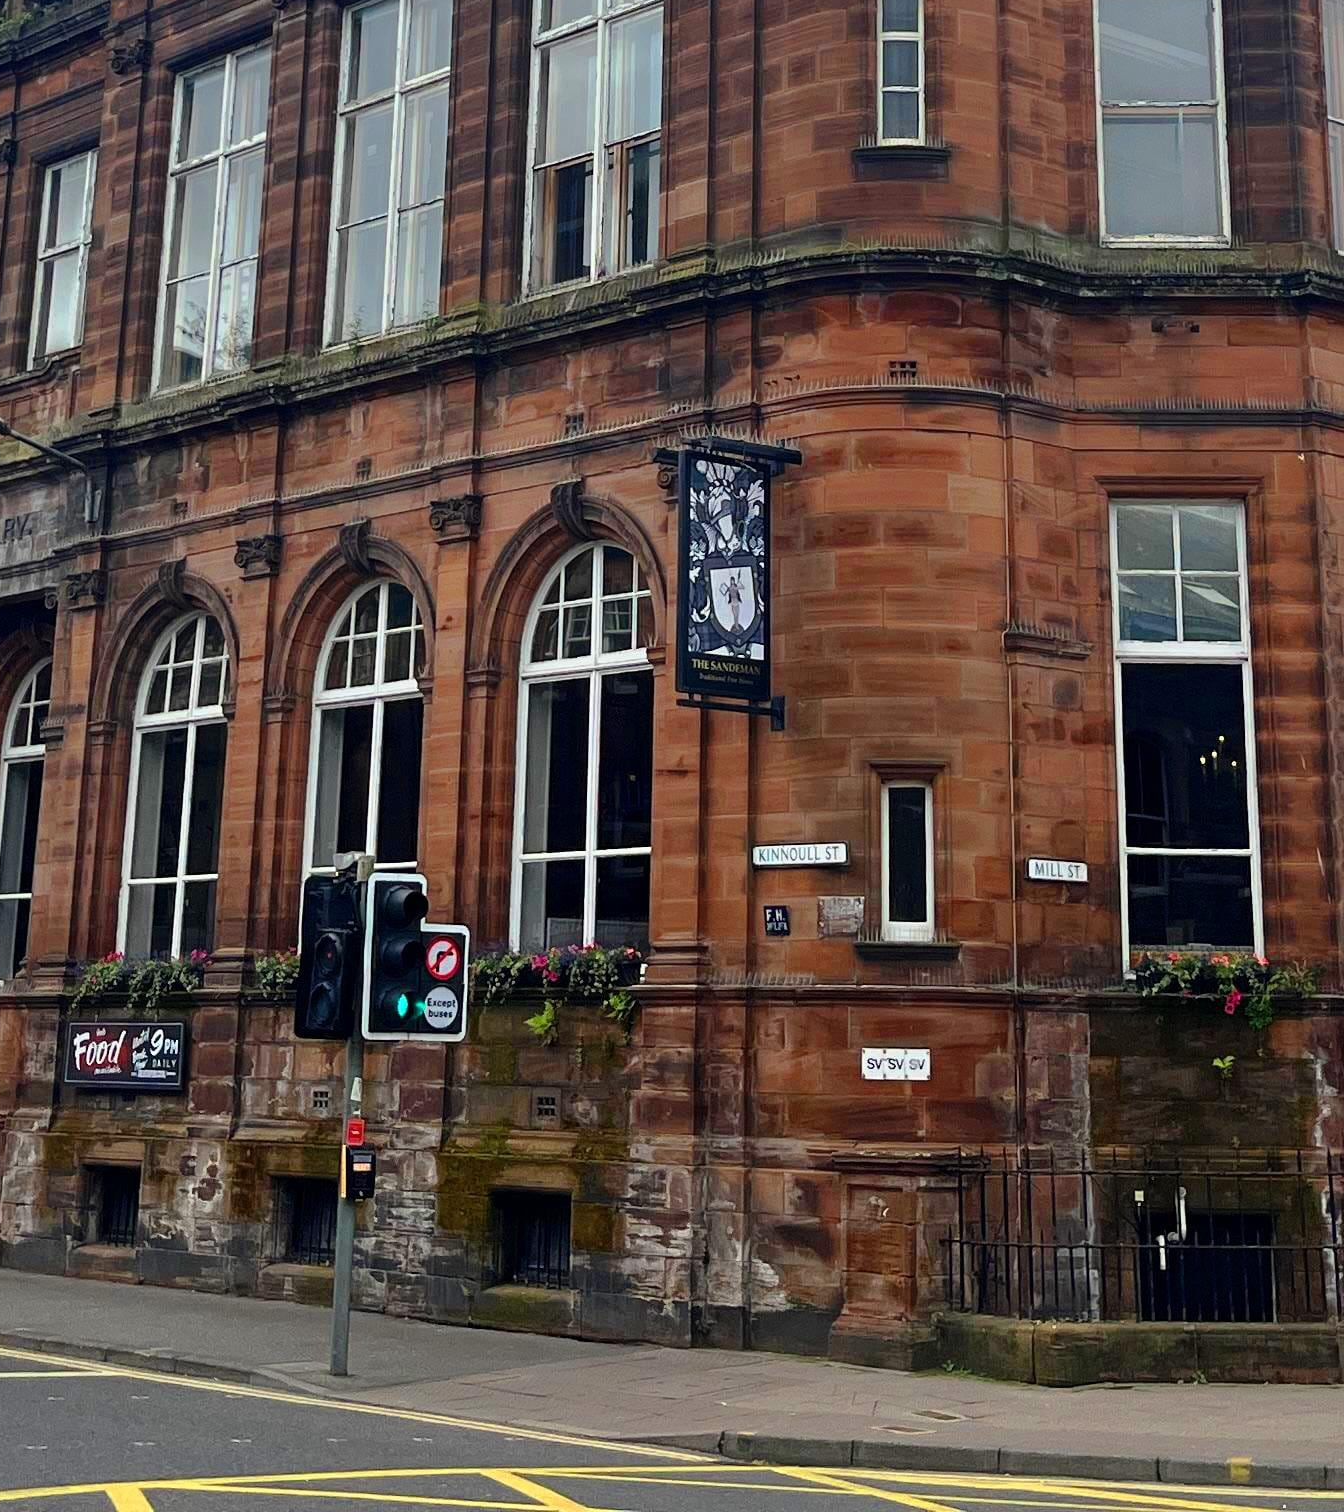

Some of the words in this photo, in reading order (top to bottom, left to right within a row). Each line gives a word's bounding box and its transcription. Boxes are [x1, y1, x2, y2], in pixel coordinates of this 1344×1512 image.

[692, 658, 709, 670] THE
[710, 661, 760, 675] SANDEMAN
[758, 846, 821, 863] KINNOULL
[825, 845, 839, 861] ST
[1034, 862, 1063, 878] MILL
[1067, 864, 1080, 879] ST
[427, 997, 456, 1009] Except
[428, 1009, 453, 1018] buses
[73, 1030, 127, 1071] Food
[152, 1058, 177, 1068] DAILY
[866, 1057, 883, 1070] SV
[887, 1057, 905, 1070] SV
[908, 1058, 926, 1071] SV
